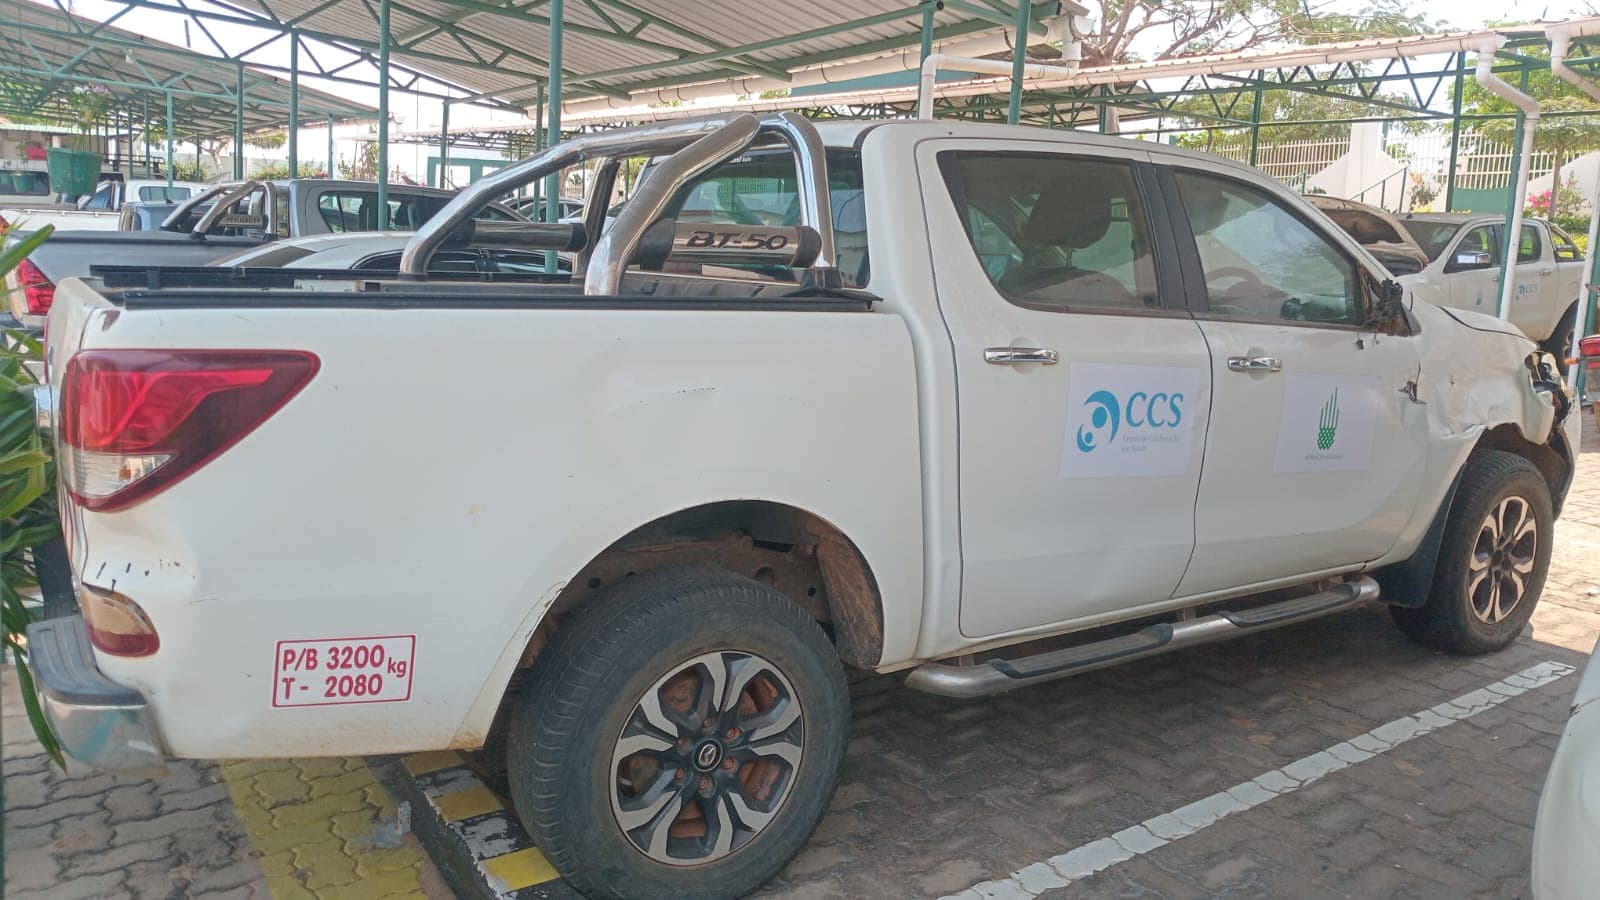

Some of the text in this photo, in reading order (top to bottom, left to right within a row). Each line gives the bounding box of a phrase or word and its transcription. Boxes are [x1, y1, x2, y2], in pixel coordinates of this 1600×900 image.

[686, 231, 788, 250] BT-50
[1125, 391, 1184, 428] CCS
[282, 644, 407, 678] P/B 3200 kg
[324, 673, 383, 698] 2080
